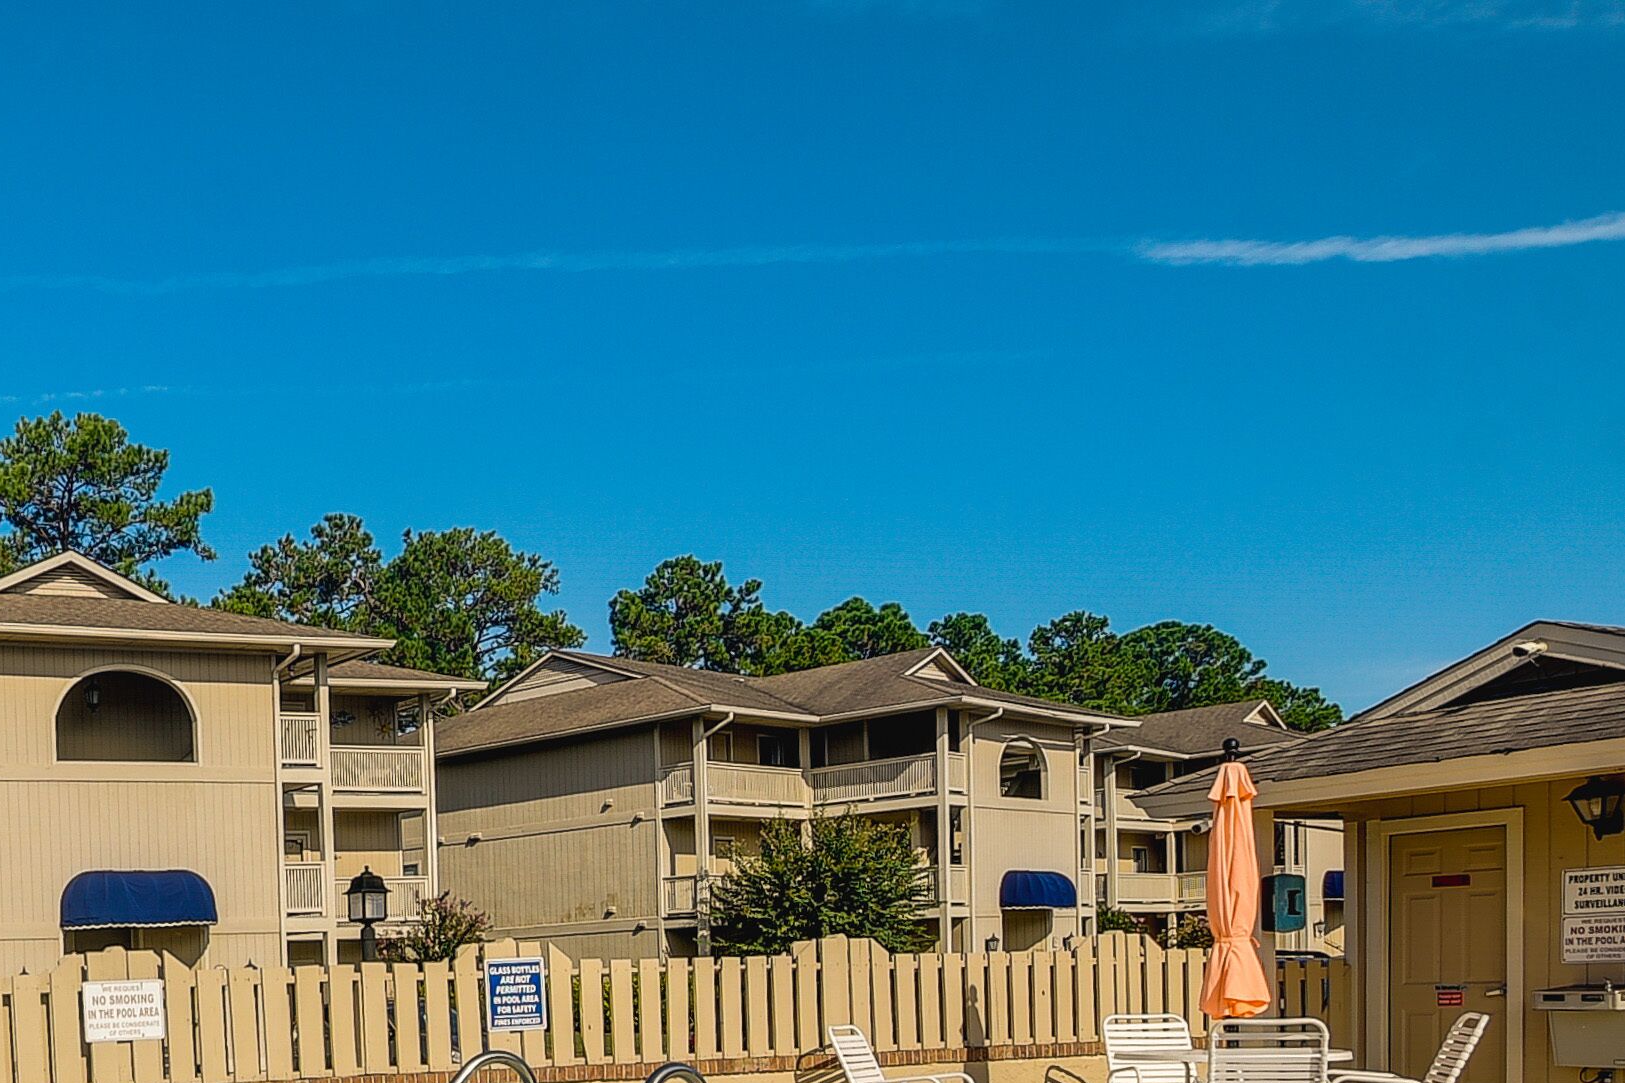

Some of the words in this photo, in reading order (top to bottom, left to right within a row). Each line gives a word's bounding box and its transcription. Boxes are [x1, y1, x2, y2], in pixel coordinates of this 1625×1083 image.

[1569, 873, 1610, 884] PROPERTY
[1578, 887, 1588, 896] 24
[1606, 885, 1625, 895] VIDE
[1570, 926, 1585, 935] NO
[1565, 937, 1574, 946] IN
[1576, 937, 1593, 946] THE
[1594, 936, 1618, 946] POOL
[489, 966, 511, 975] GLASS
[515, 974, 531, 984] NOT
[496, 984, 536, 995] PERMITTED
[92, 995, 106, 1006] NO
[109, 994, 154, 1005] SMOKING
[502, 996, 520, 1004] POOL
[522, 995, 540, 1003] AREA
[88, 1010, 97, 1020] IN
[99, 1009, 114, 1019] THE
[116, 1008, 138, 1018] POOL
[138, 1006, 160, 1018] AREA
[496, 1006, 512, 1014] FOR
[512, 1005, 536, 1014] SAFETY
[89, 1022, 111, 1030] PLEASE
[118, 1028, 141, 1036] OTHERS
